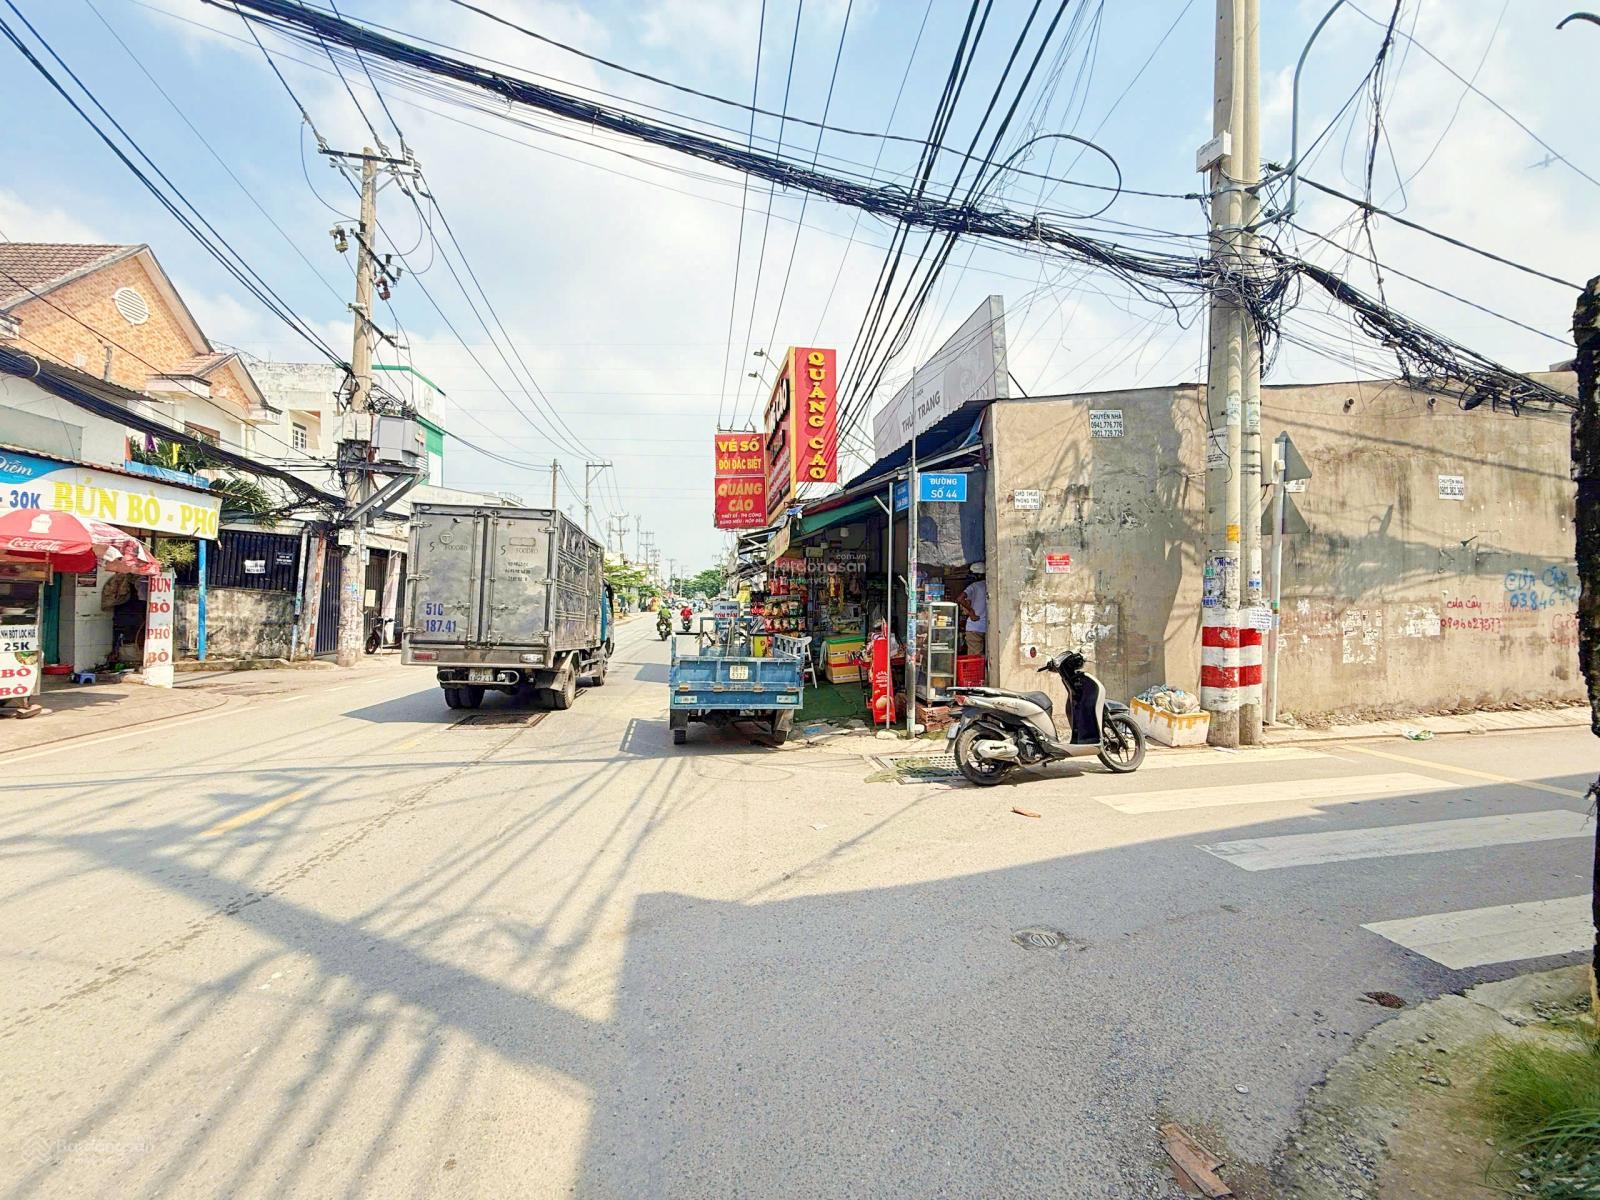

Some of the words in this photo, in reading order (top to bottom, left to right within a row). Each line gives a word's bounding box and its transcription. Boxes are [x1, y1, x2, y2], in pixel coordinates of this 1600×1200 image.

[918, 390, 941, 420] TRANG
[718, 438, 738, 452] VÉ
[740, 436, 760, 452] SỐ
[10, 490, 41, 509] 30K
[930, 486, 944, 498] SỐ
[946, 489, 957, 498] 44
[53, 477, 119, 520] BÚN
[127, 490, 161, 526] BÒ
[149, 573, 171, 592] BÚN
[149, 599, 170, 613] BÒ
[426, 619, 457, 633] 187.41
[4, 641, 30, 651] 25K
[147, 648, 169, 664] BÒ
[1, 665, 31, 678] BÒ
[0, 684, 28, 696] BÒ
